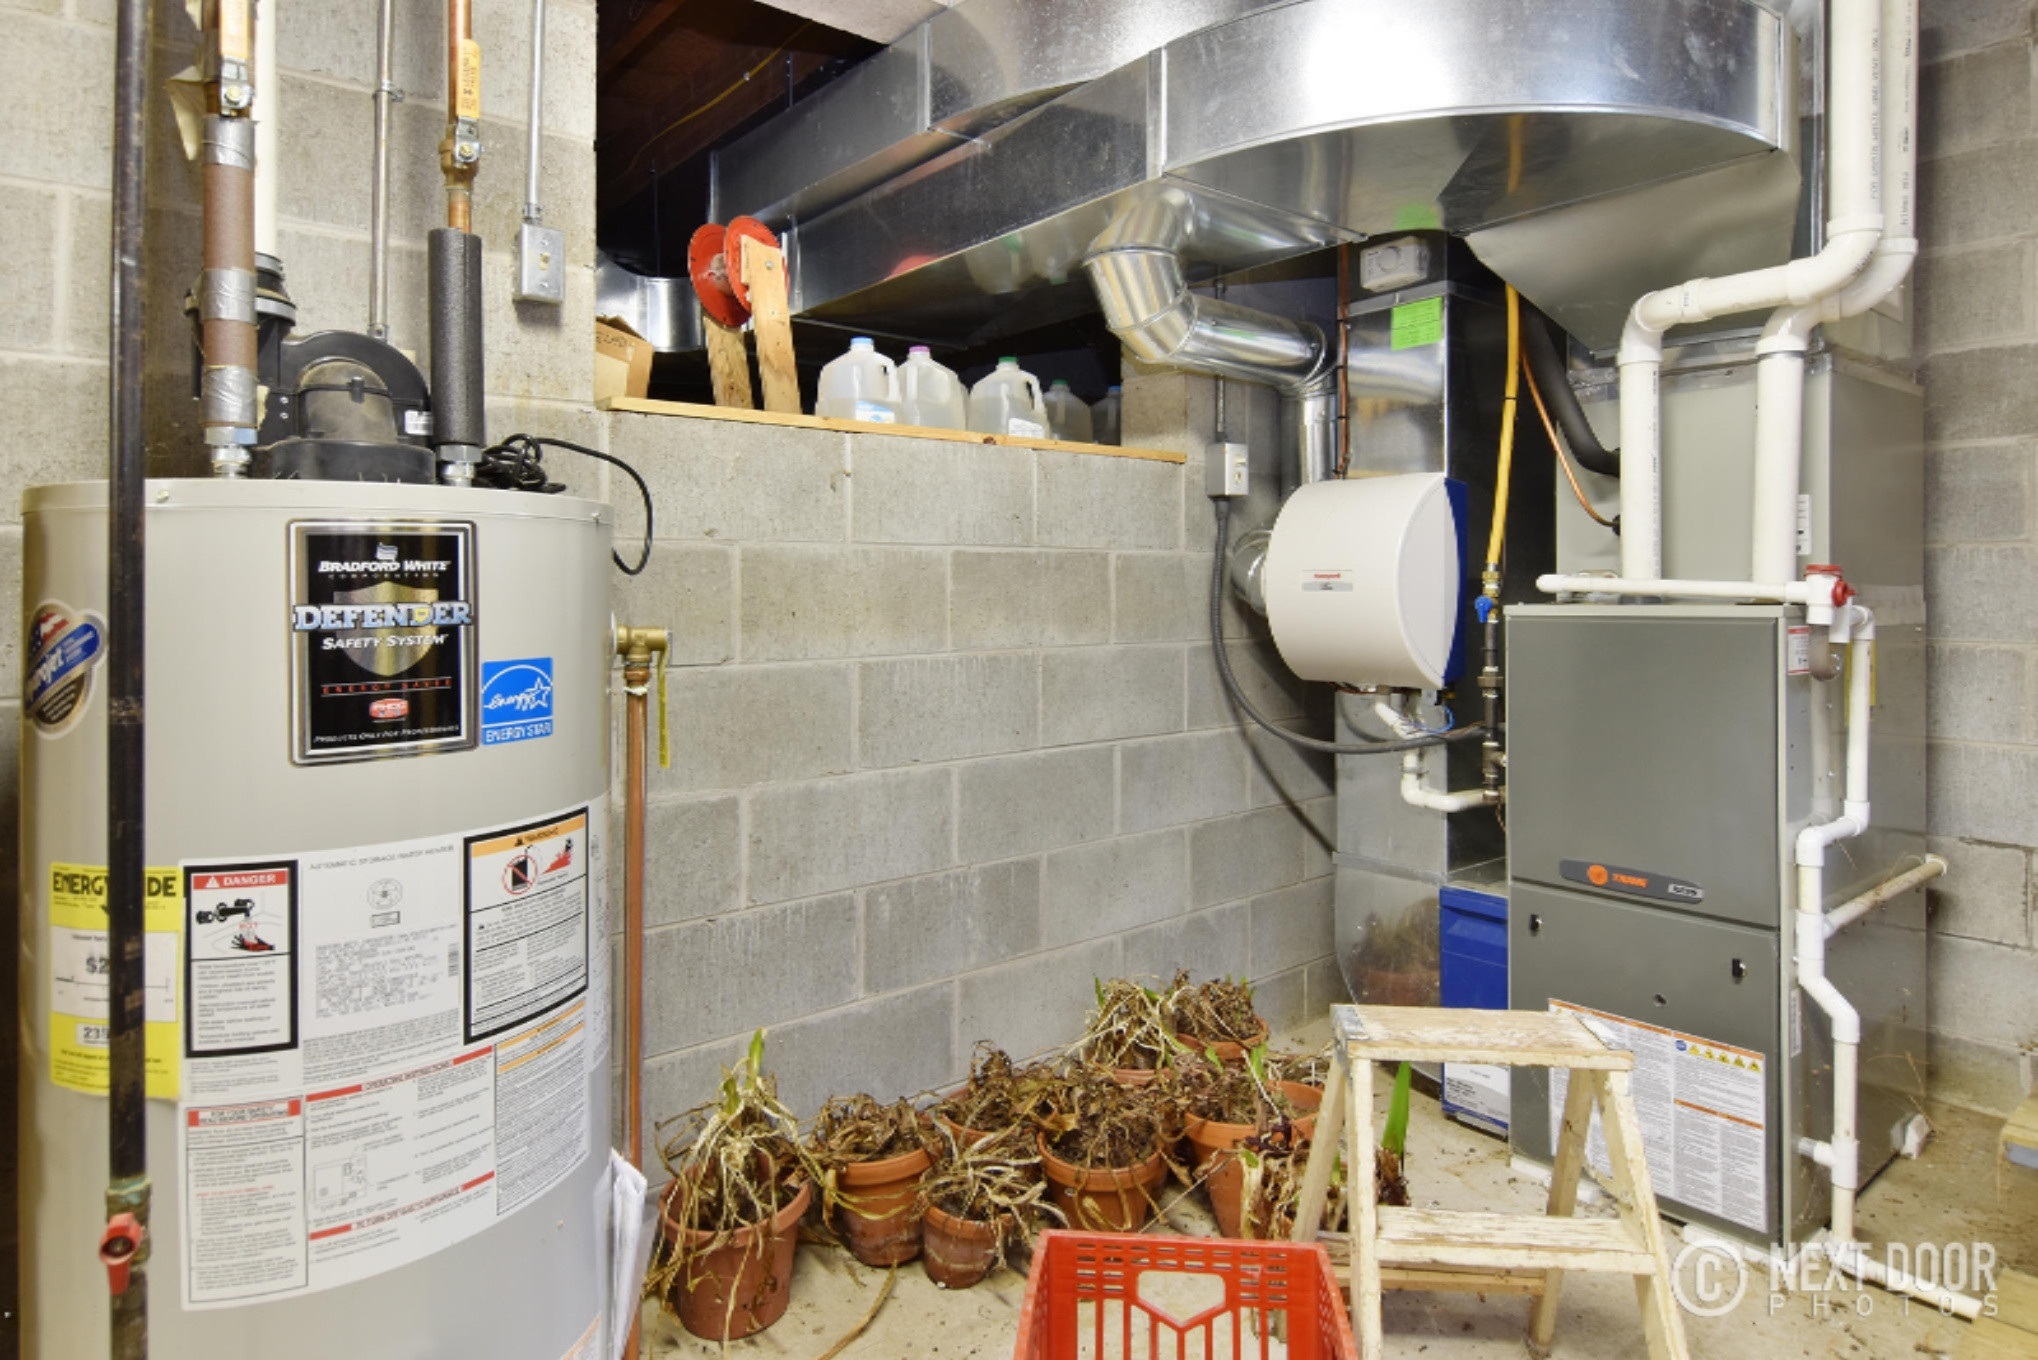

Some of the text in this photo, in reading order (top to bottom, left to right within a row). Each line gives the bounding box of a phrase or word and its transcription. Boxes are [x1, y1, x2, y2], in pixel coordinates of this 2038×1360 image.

[318, 560, 447, 573] BRADFORD WHITE
[294, 601, 471, 630] DEFENDER
[321, 634, 446, 650] SAFETY SYSTEM
[224, 874, 276, 886] DANGER
